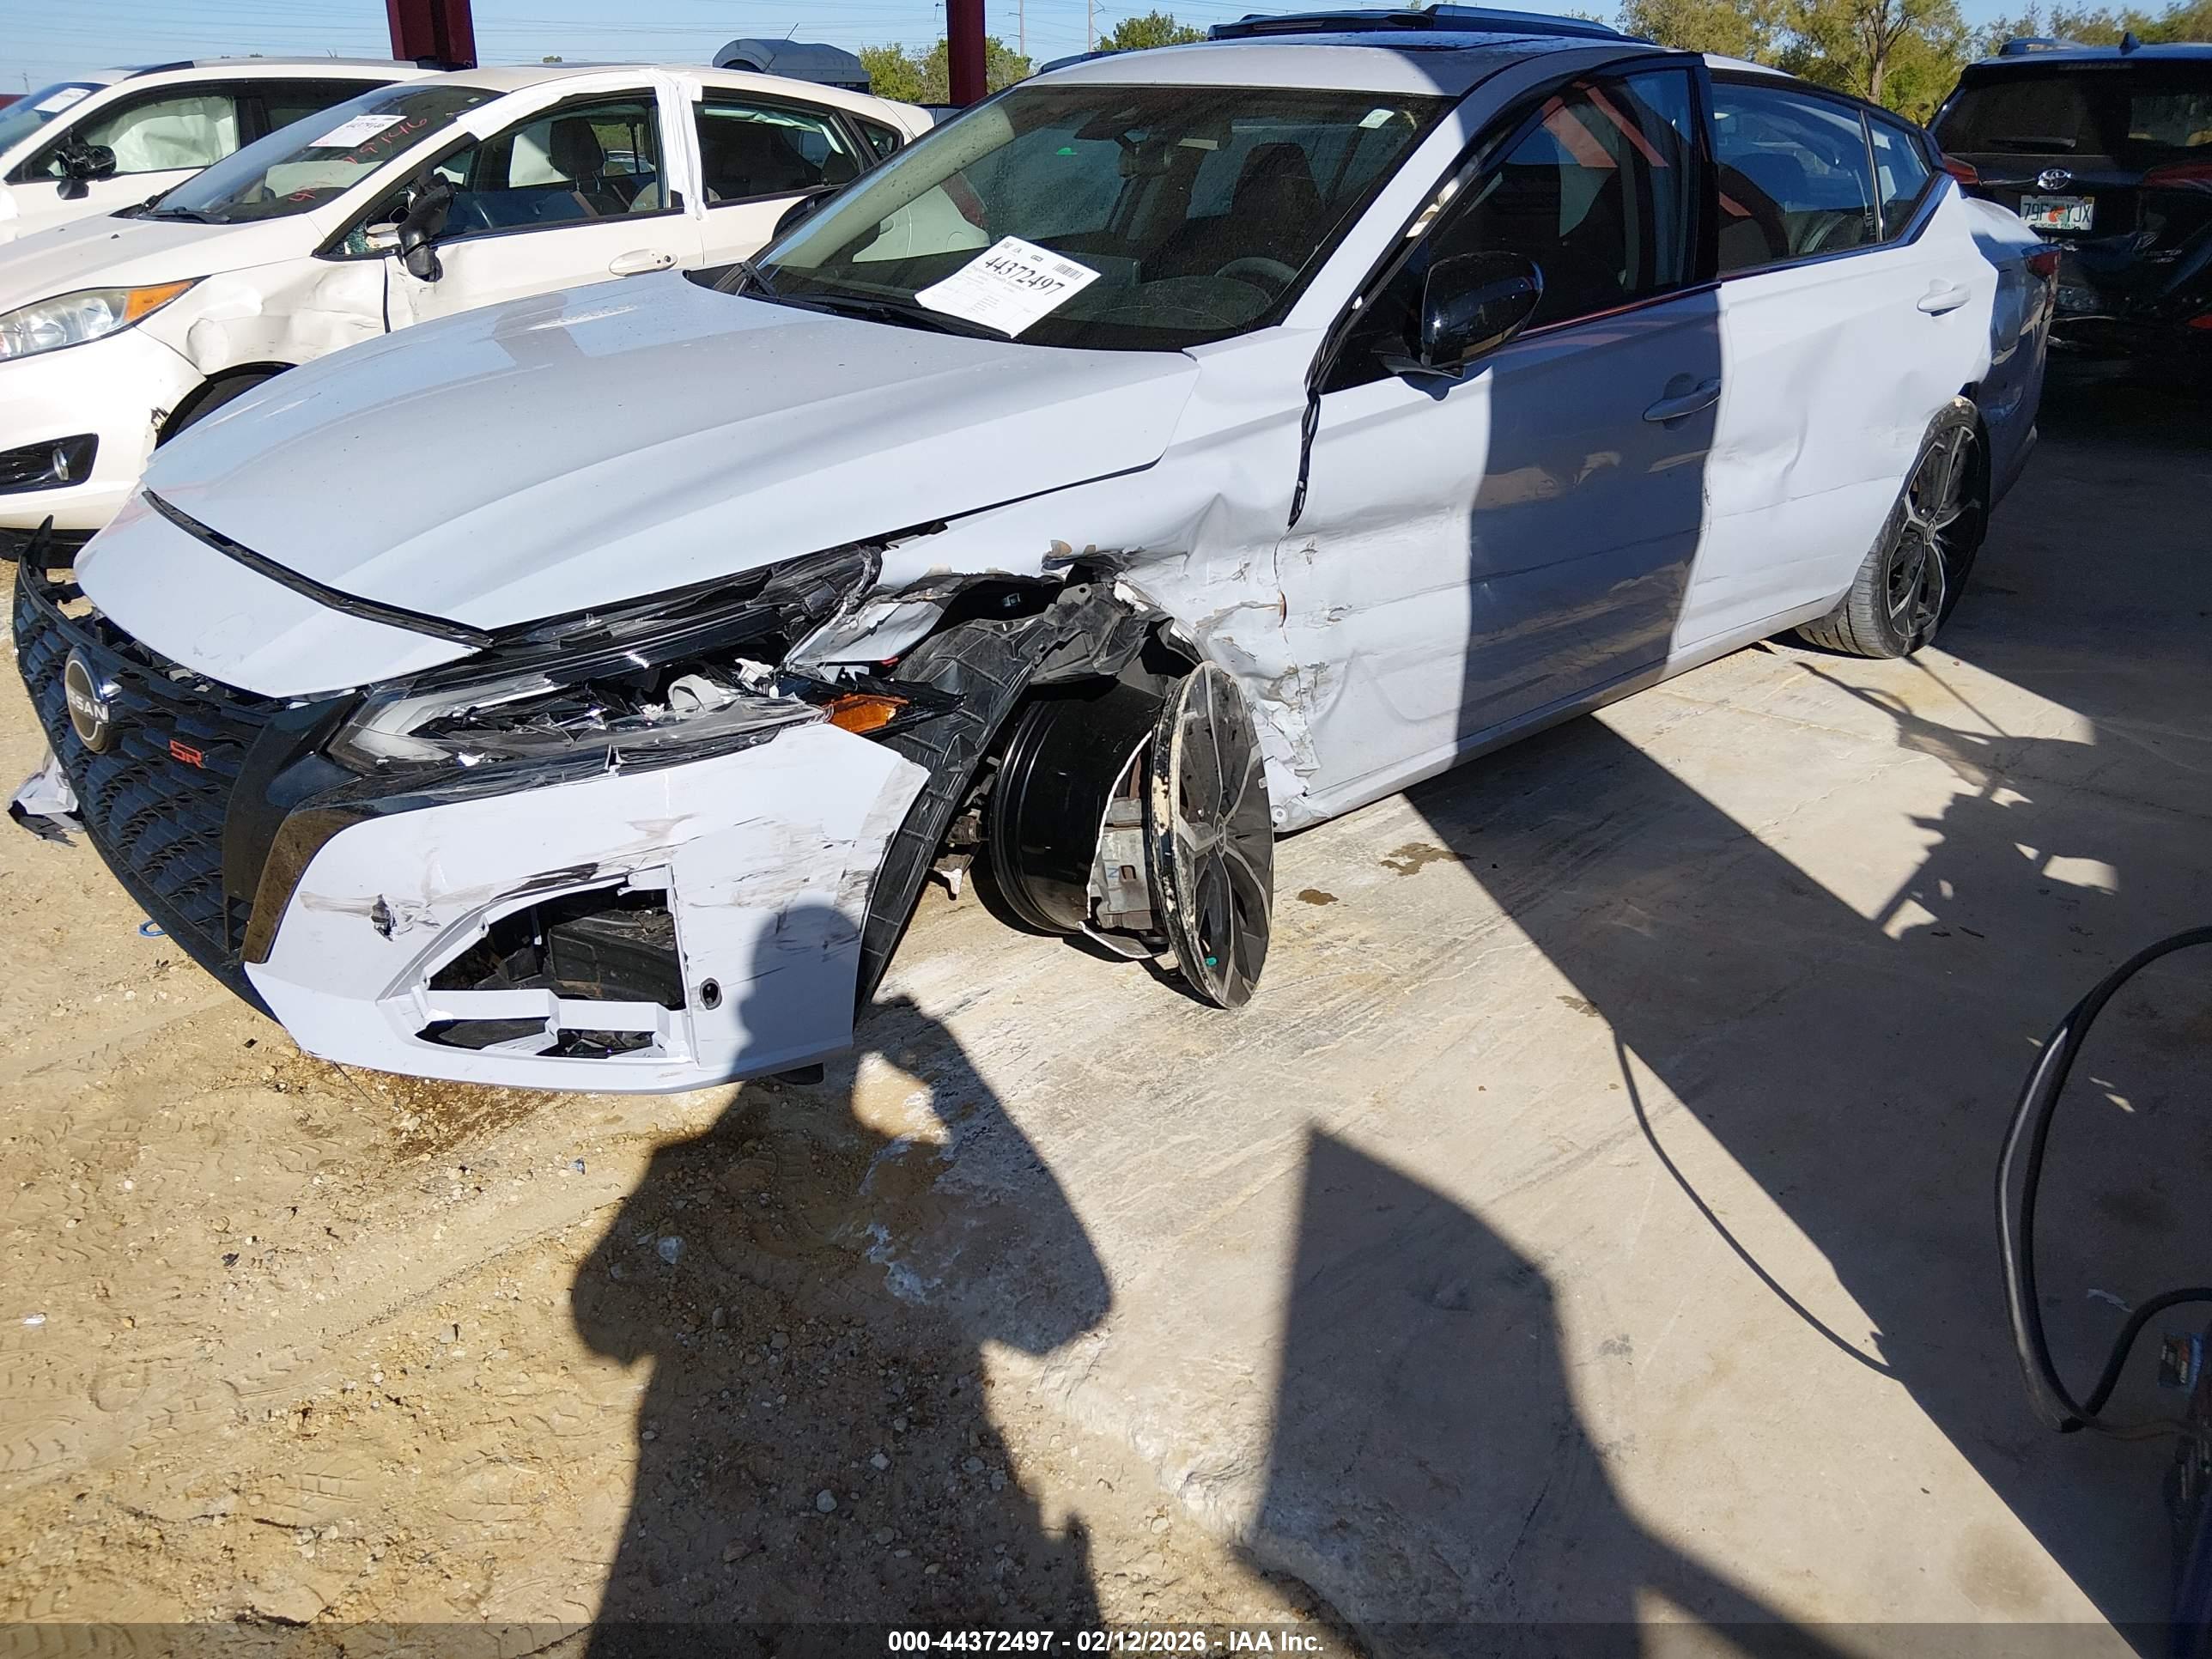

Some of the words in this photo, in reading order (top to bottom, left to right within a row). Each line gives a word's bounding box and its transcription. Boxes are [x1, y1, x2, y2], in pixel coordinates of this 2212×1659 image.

[2066, 204, 2091, 223] YJX
[985, 256, 1066, 295] 44372497
[169, 738, 204, 769] SR
